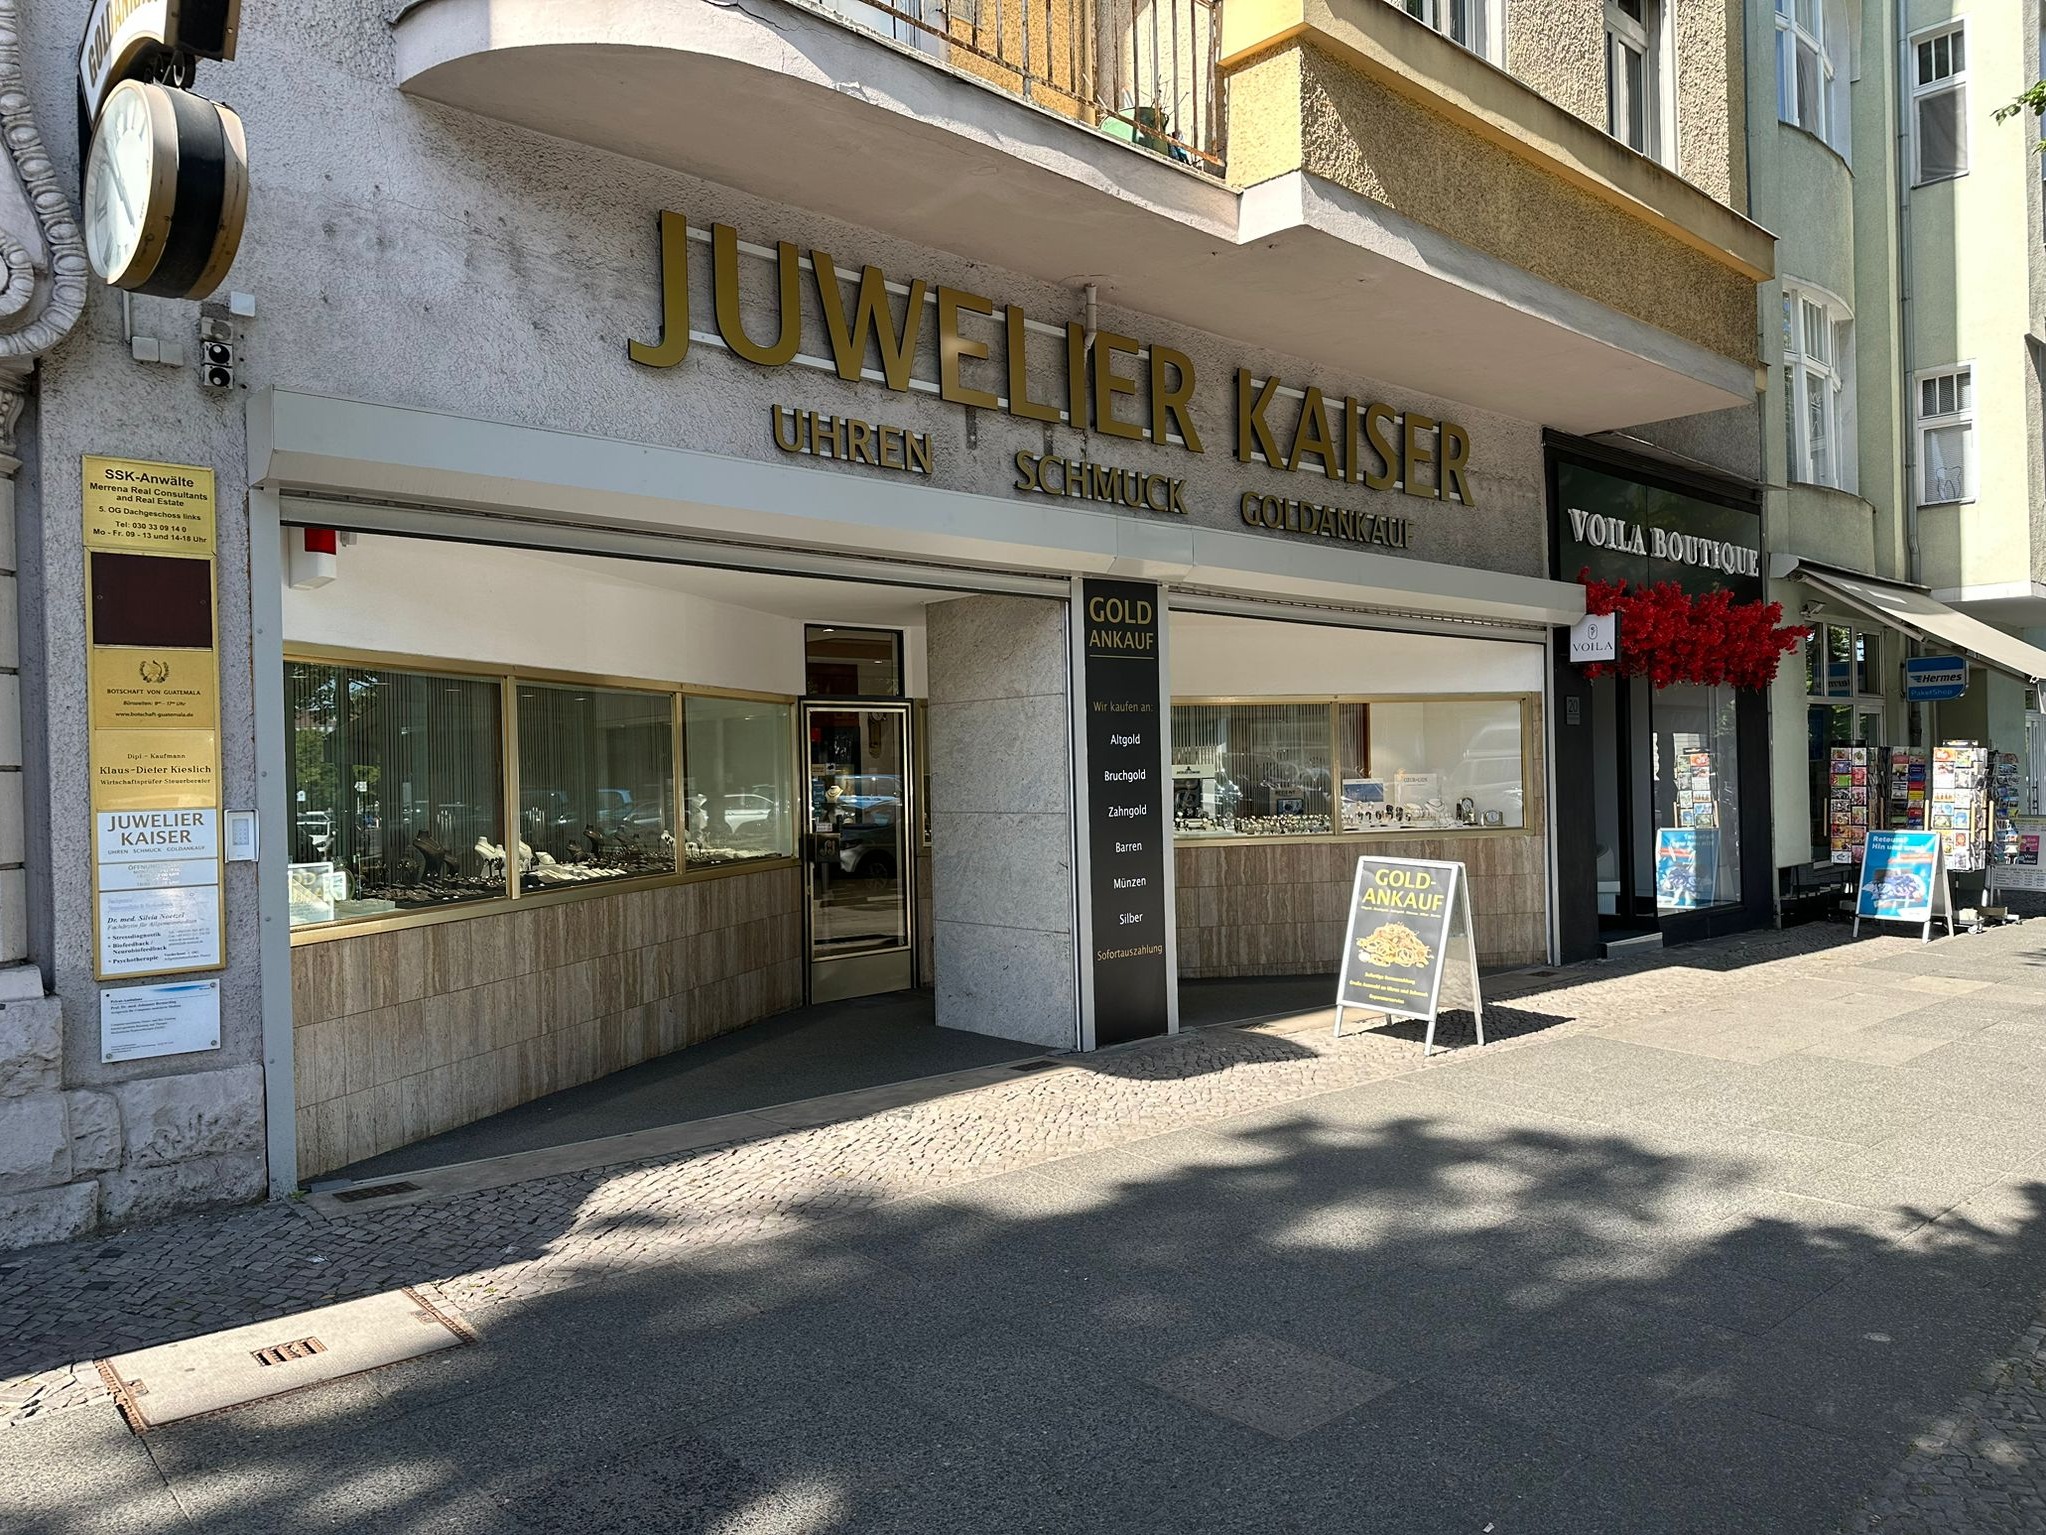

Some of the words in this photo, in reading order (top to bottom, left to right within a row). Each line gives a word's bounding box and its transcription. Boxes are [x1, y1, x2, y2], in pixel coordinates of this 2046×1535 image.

[628, 209, 1204, 453] JUWELIER
[1236, 367, 1474, 508] KAISER
[105, 469, 194, 487] SSK-Anwälte
[772, 404, 932, 474] UHREN
[1015, 450, 1188, 514] SCHMUCK
[1240, 491, 1414, 549] GOLDANKAUF
[131, 487, 151, 495] Real
[154, 488, 207, 501] Consultants
[135, 496, 155, 504] Real
[157, 498, 184, 506] Estate
[124, 508, 180, 519] Dachgeschoss
[183, 513, 201, 521] links
[153, 533, 168, 541] und
[193, 535, 207, 543] Uhr
[1568, 508, 1647, 556] VOILA
[1649, 527, 1759, 577] BOUTIQUE
[1089, 596, 1152, 625] GOLD
[1089, 629, 1154, 650] ANKAUF
[1572, 641, 1614, 652] VOILA
[1921, 673, 1963, 683] Hermes
[1911, 689, 1952, 697] PaketShop
[1093, 701, 1107, 712] Wir
[1110, 700, 1139, 712] kaufen
[1140, 702, 1153, 712] an:
[1110, 733, 1140, 747] Altgold
[100, 766, 168, 774] Klaus-Dieter
[171, 765, 211, 774] Kieslich
[1104, 769, 1146, 782] Bruchgold
[1108, 804, 1147, 818] Zahngold
[107, 812, 204, 832] JUWELIER
[121, 830, 192, 846] KAISER
[1115, 842, 1142, 853] Barren
[1113, 877, 1147, 889] Münzen
[1375, 869, 1436, 889] GOLD-
[1362, 888, 1444, 911] ANKAUF
[1119, 912, 1143, 925] Silber
[1097, 944, 1163, 961] Sofortauszahlung
